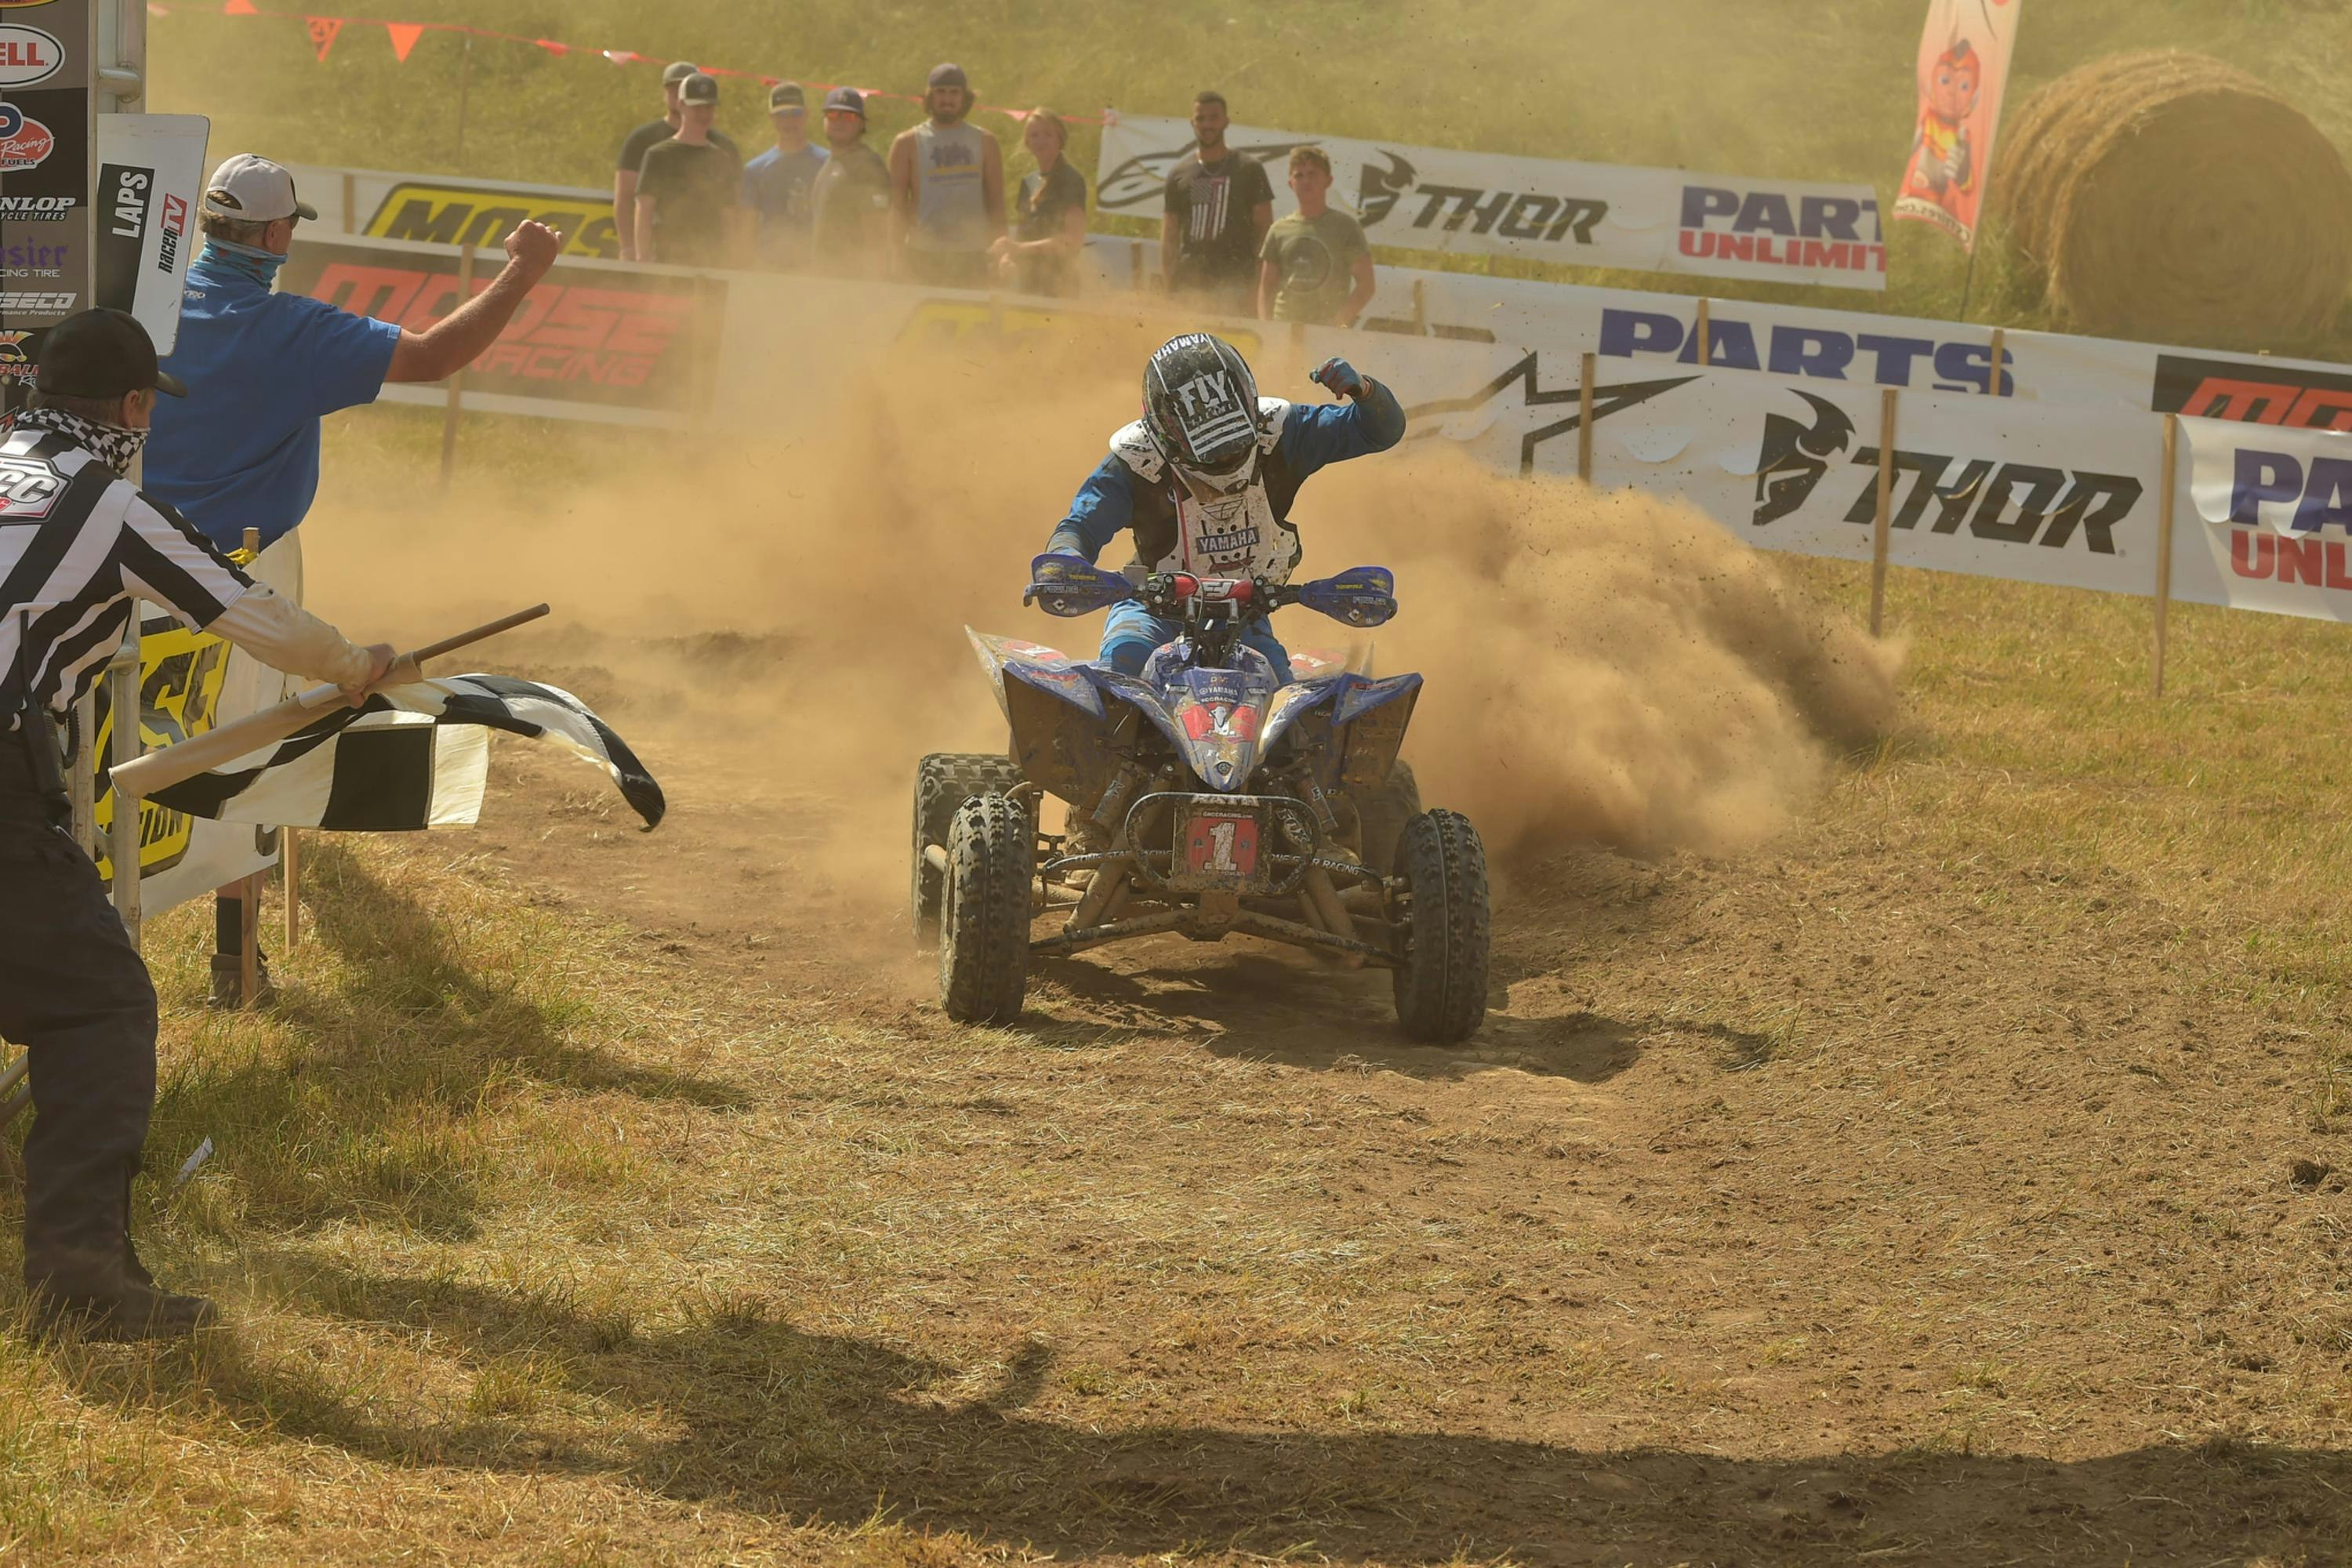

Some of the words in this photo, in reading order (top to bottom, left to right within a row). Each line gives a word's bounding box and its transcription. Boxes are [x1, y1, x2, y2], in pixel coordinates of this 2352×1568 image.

[2, 136, 55, 158] Racing
[34, 212, 66, 221] TIRES
[112, 172, 148, 238] LAPS
[1412, 183, 1610, 245] THOR
[33, 269, 60, 278] TIRE
[1153, 333, 1209, 361] YAMAHA
[1599, 308, 2014, 397] PARTS
[1177, 370, 1229, 417] FLY
[1843, 445, 2143, 555] THOR
[1200, 531, 1258, 552] YAMAHA
[1203, 822, 1238, 871] 1
[1323, 860, 1361, 875] RACING
